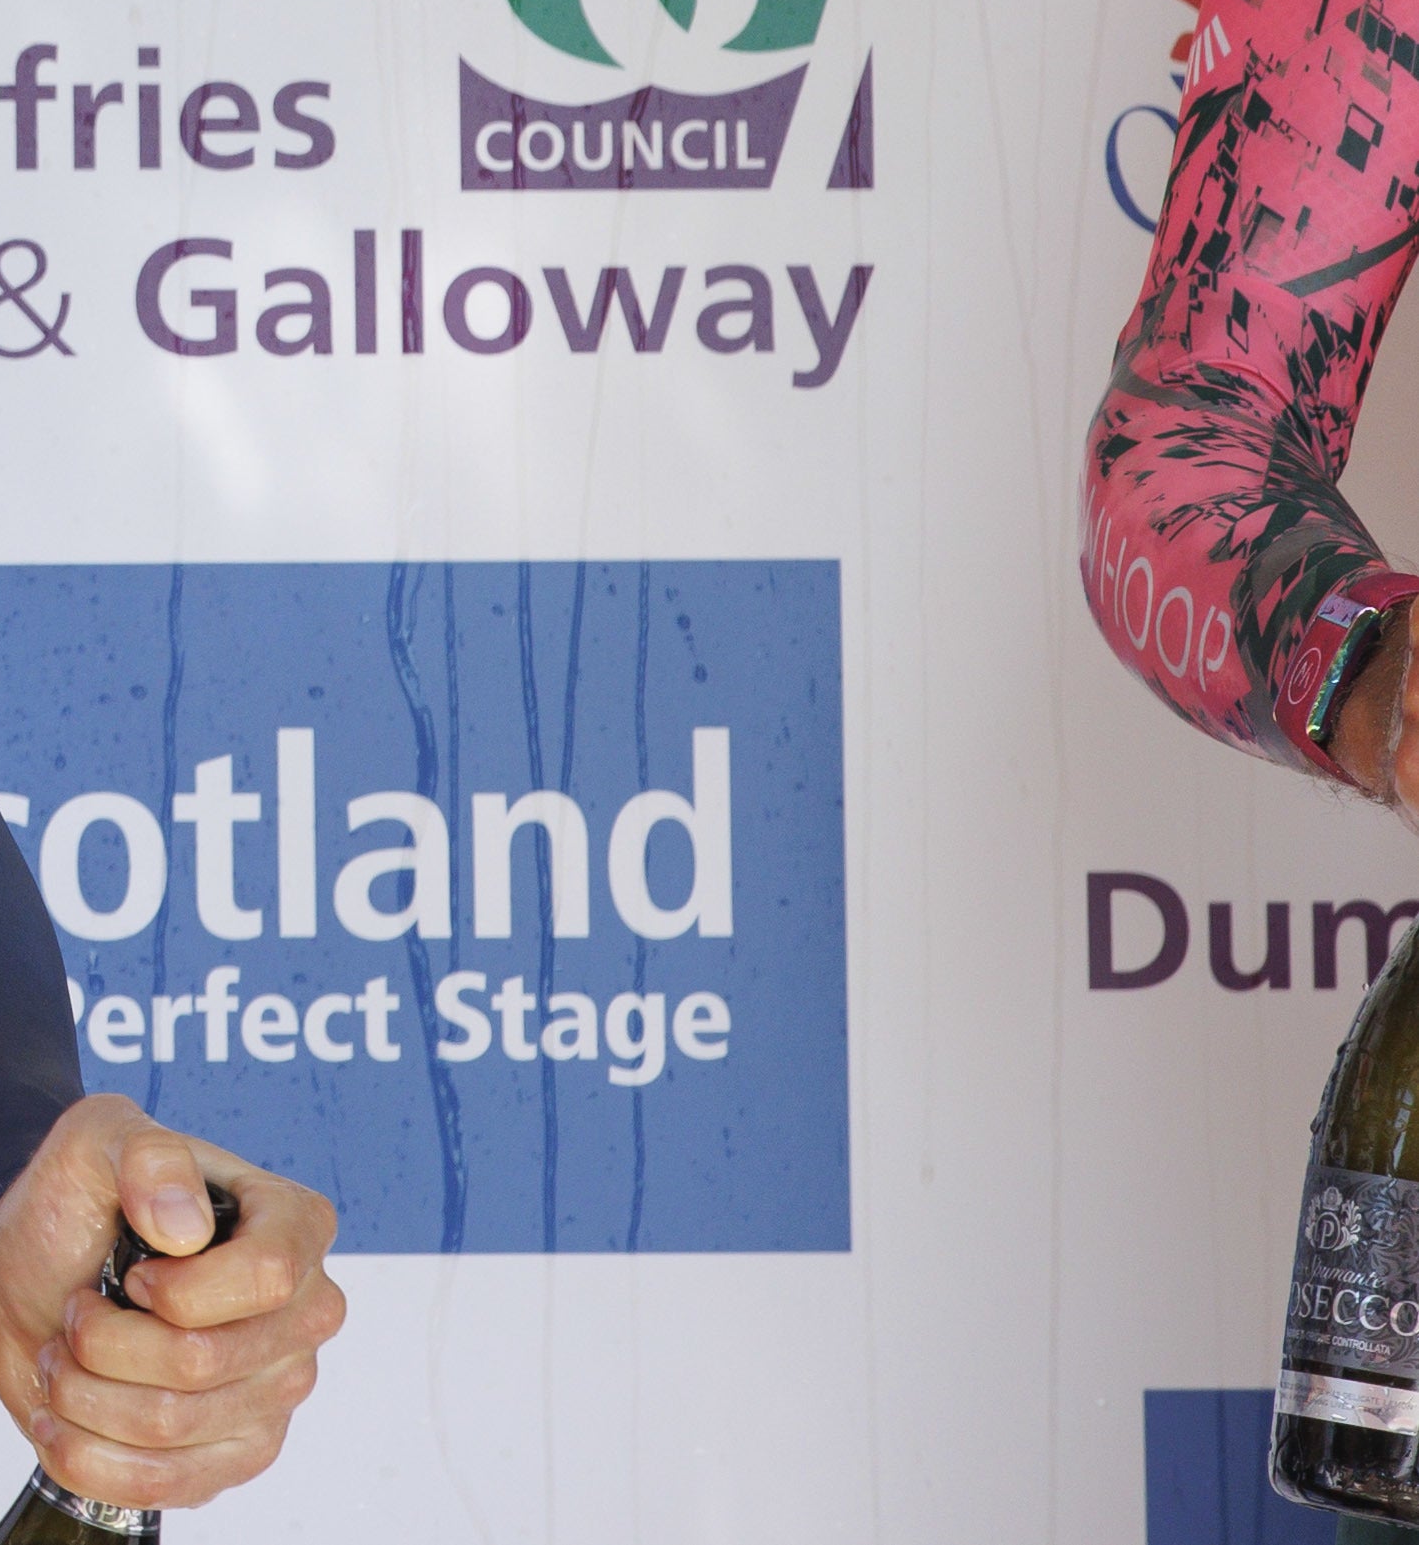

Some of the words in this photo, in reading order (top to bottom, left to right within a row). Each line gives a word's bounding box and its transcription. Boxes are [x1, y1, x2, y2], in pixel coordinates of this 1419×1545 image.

[474, 117, 767, 173] COUNCIL
[135, 228, 875, 390] Galloway
[436, 970, 732, 1086] Stage
[1332, 1336, 1392, 1356] CONTROLLATA
